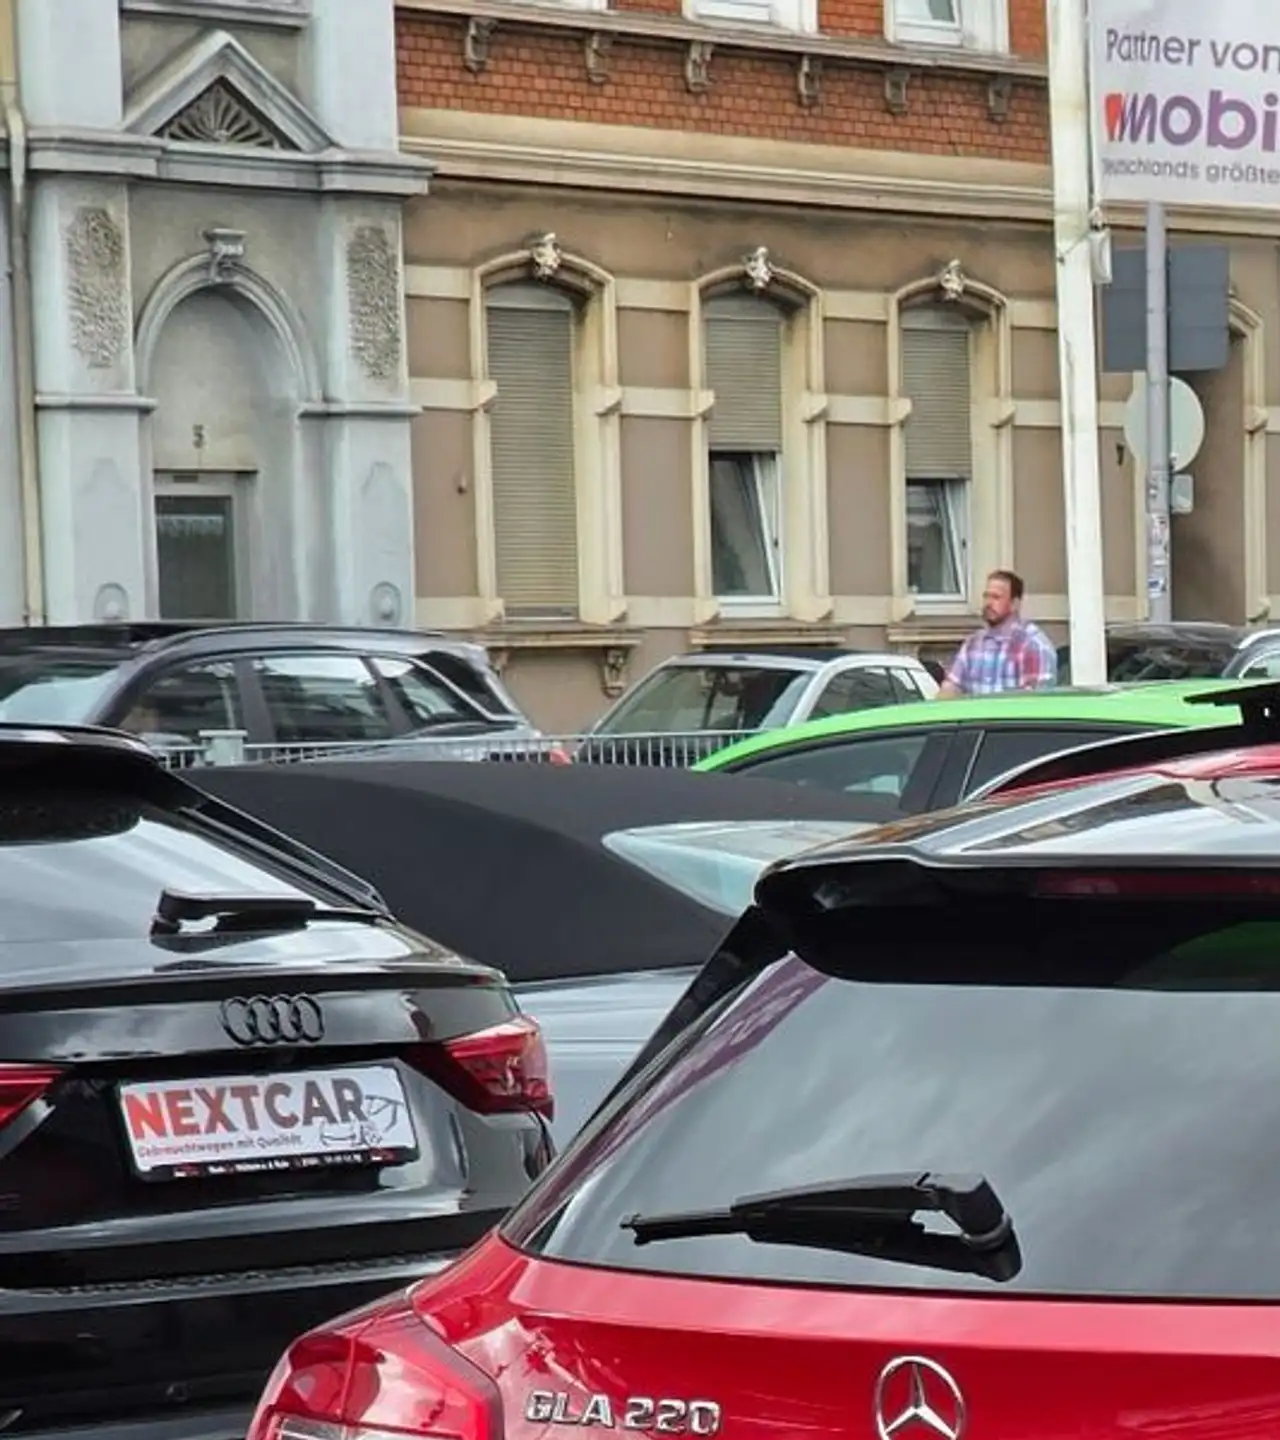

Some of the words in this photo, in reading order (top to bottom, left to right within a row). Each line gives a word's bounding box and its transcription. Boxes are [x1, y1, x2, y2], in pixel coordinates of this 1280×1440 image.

[1106, 28, 1200, 66] Partner
[125, 1078, 368, 1140] NEXTCAR
[525, 1389, 615, 1428] GLA
[624, 1397, 721, 1435] 220
